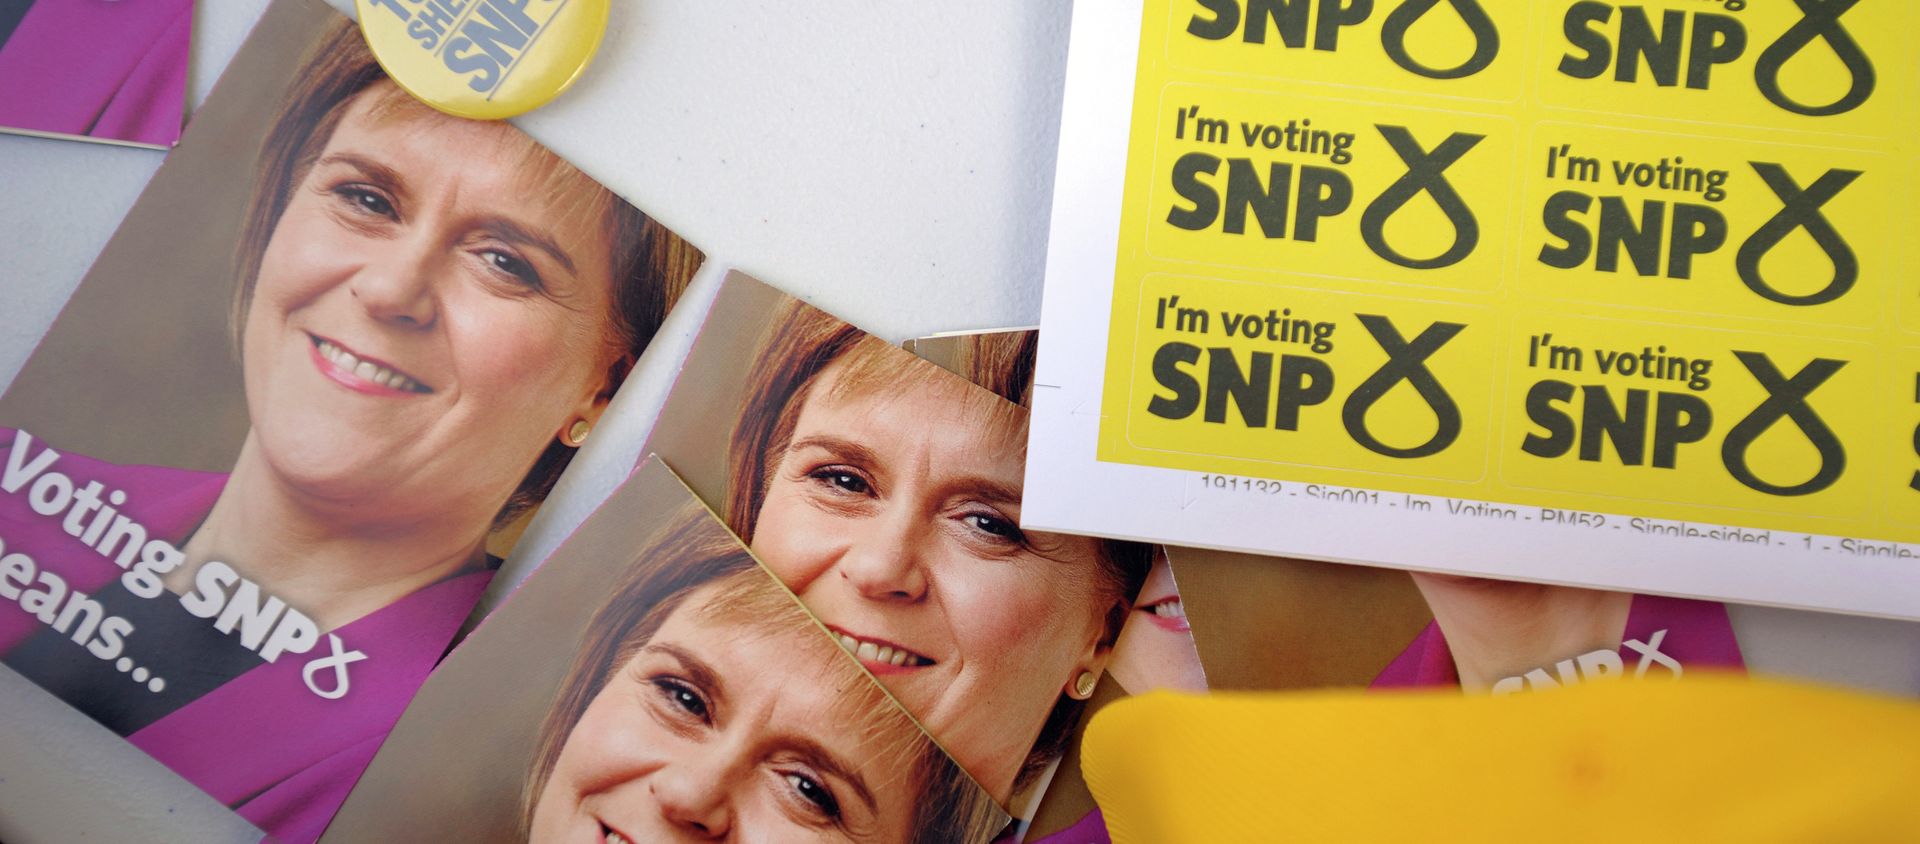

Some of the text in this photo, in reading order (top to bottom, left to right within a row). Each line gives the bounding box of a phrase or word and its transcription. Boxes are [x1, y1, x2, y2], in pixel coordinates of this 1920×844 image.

[443, 0, 540, 93] SNP
[1557, 0, 1748, 90] SNP
[1175, 105, 1355, 165] I'm voting
[1546, 144, 1729, 202] I'm voting
[1166, 151, 1354, 242] SNP
[1537, 190, 1729, 280] SNP
[1156, 295, 1336, 354] I'm voting
[1529, 333, 1713, 391] I'm voting
[1147, 341, 1336, 432] SNP
[1521, 379, 1714, 469] SNP
[0, 429, 319, 664] Voting SNP
[0, 536, 166, 694] eans...
